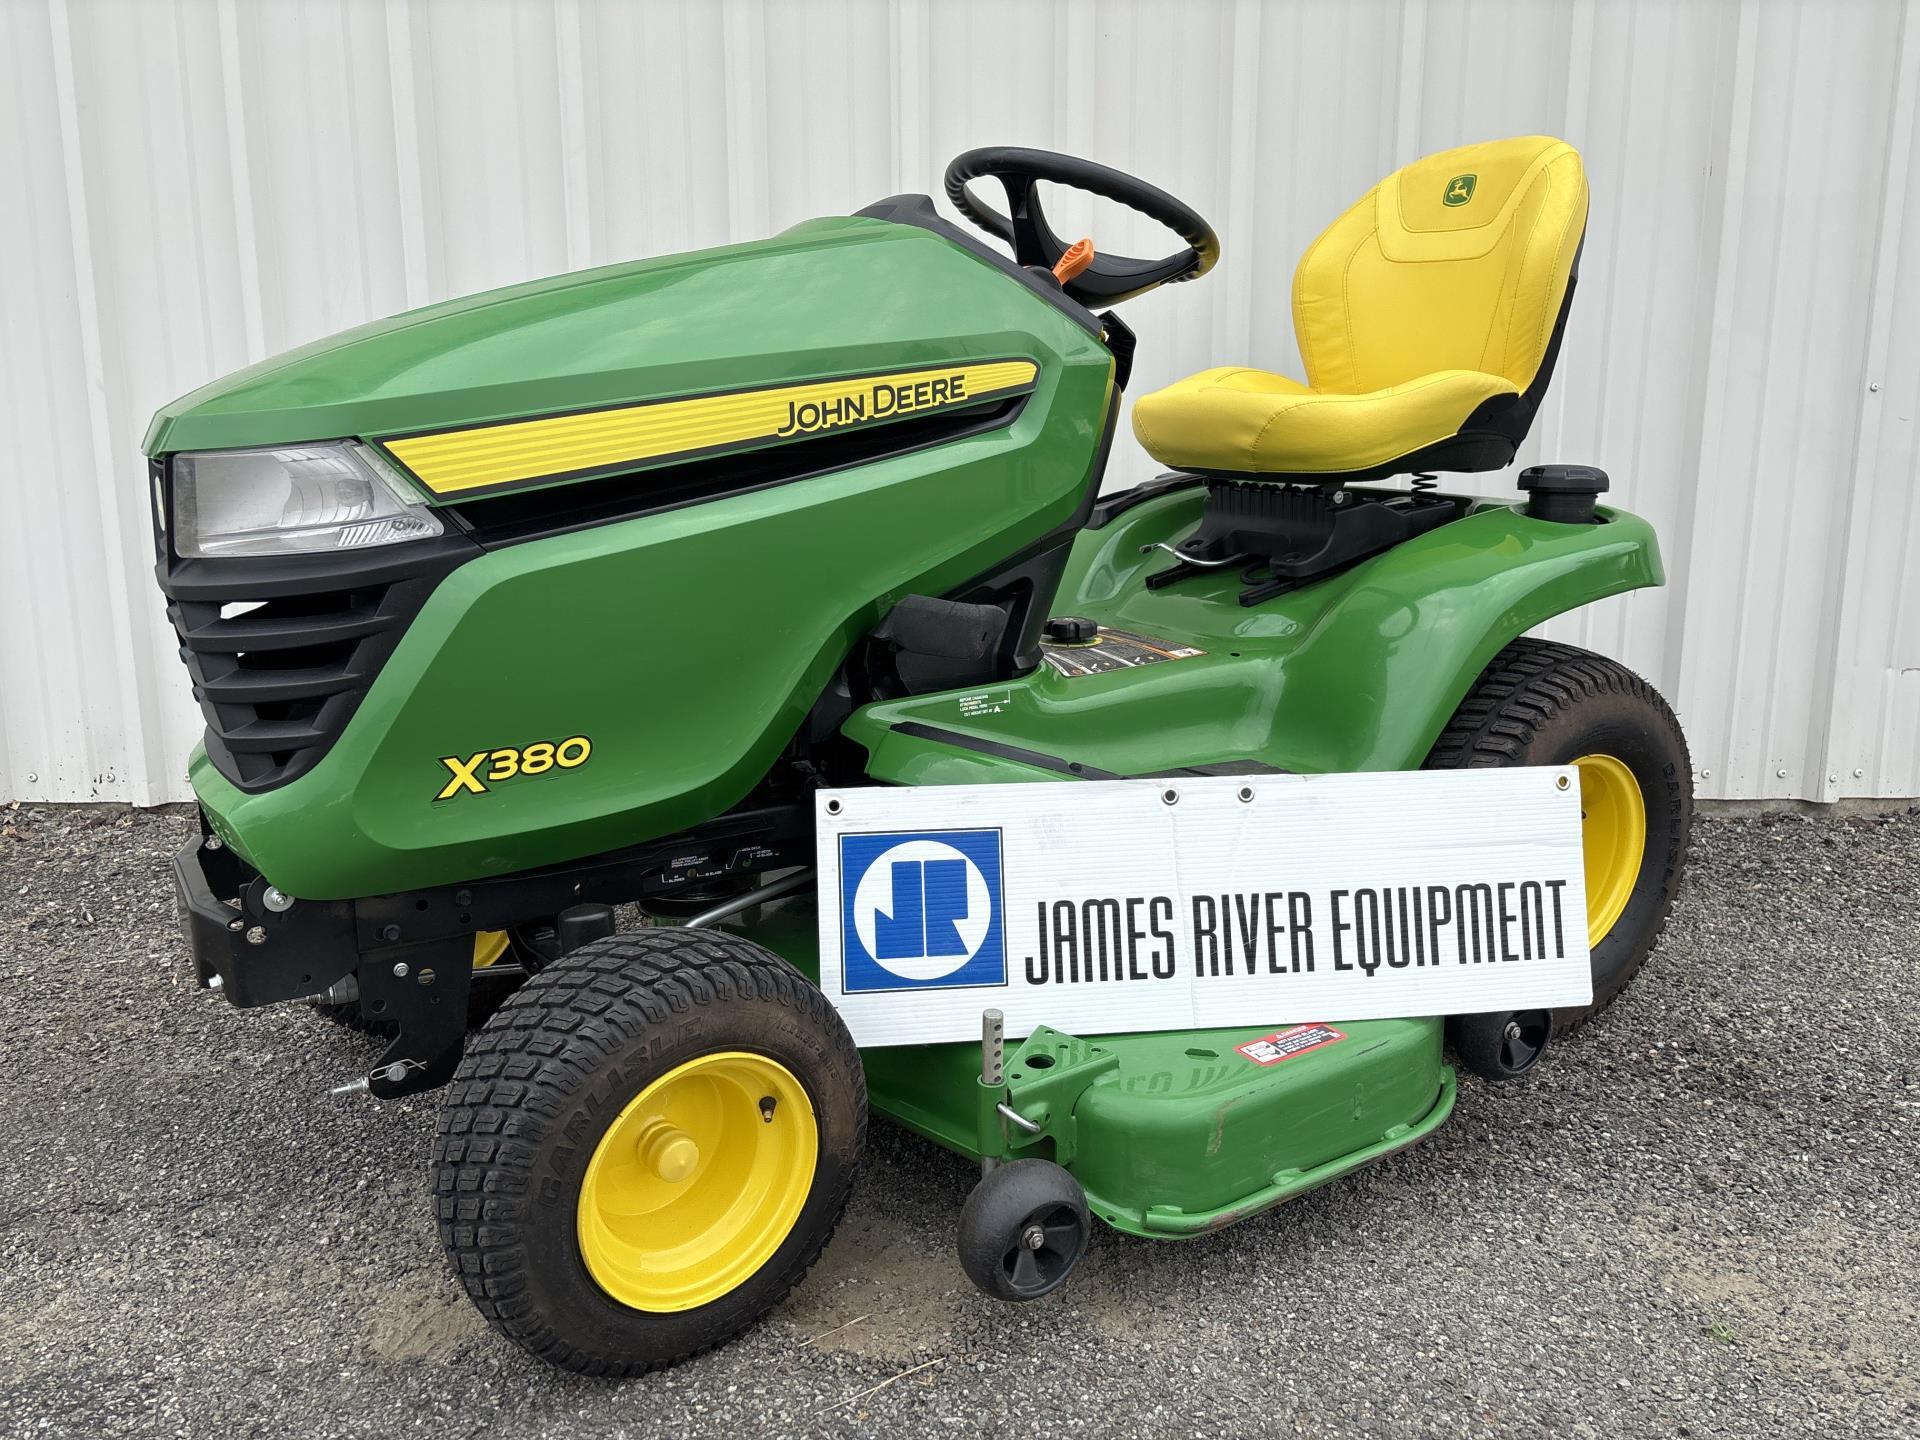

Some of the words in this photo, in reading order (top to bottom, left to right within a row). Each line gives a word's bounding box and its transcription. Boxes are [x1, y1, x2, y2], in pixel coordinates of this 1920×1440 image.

[777, 394, 866, 435] JOHN
[872, 374, 967, 416] DEERE
[432, 735, 593, 802] X380
[1025, 895, 1175, 986] JAMES
[1193, 890, 1315, 978] RIVER
[1331, 879, 1568, 978] EQUIPMENT
[539, 1016, 704, 1208] CARLISLE
